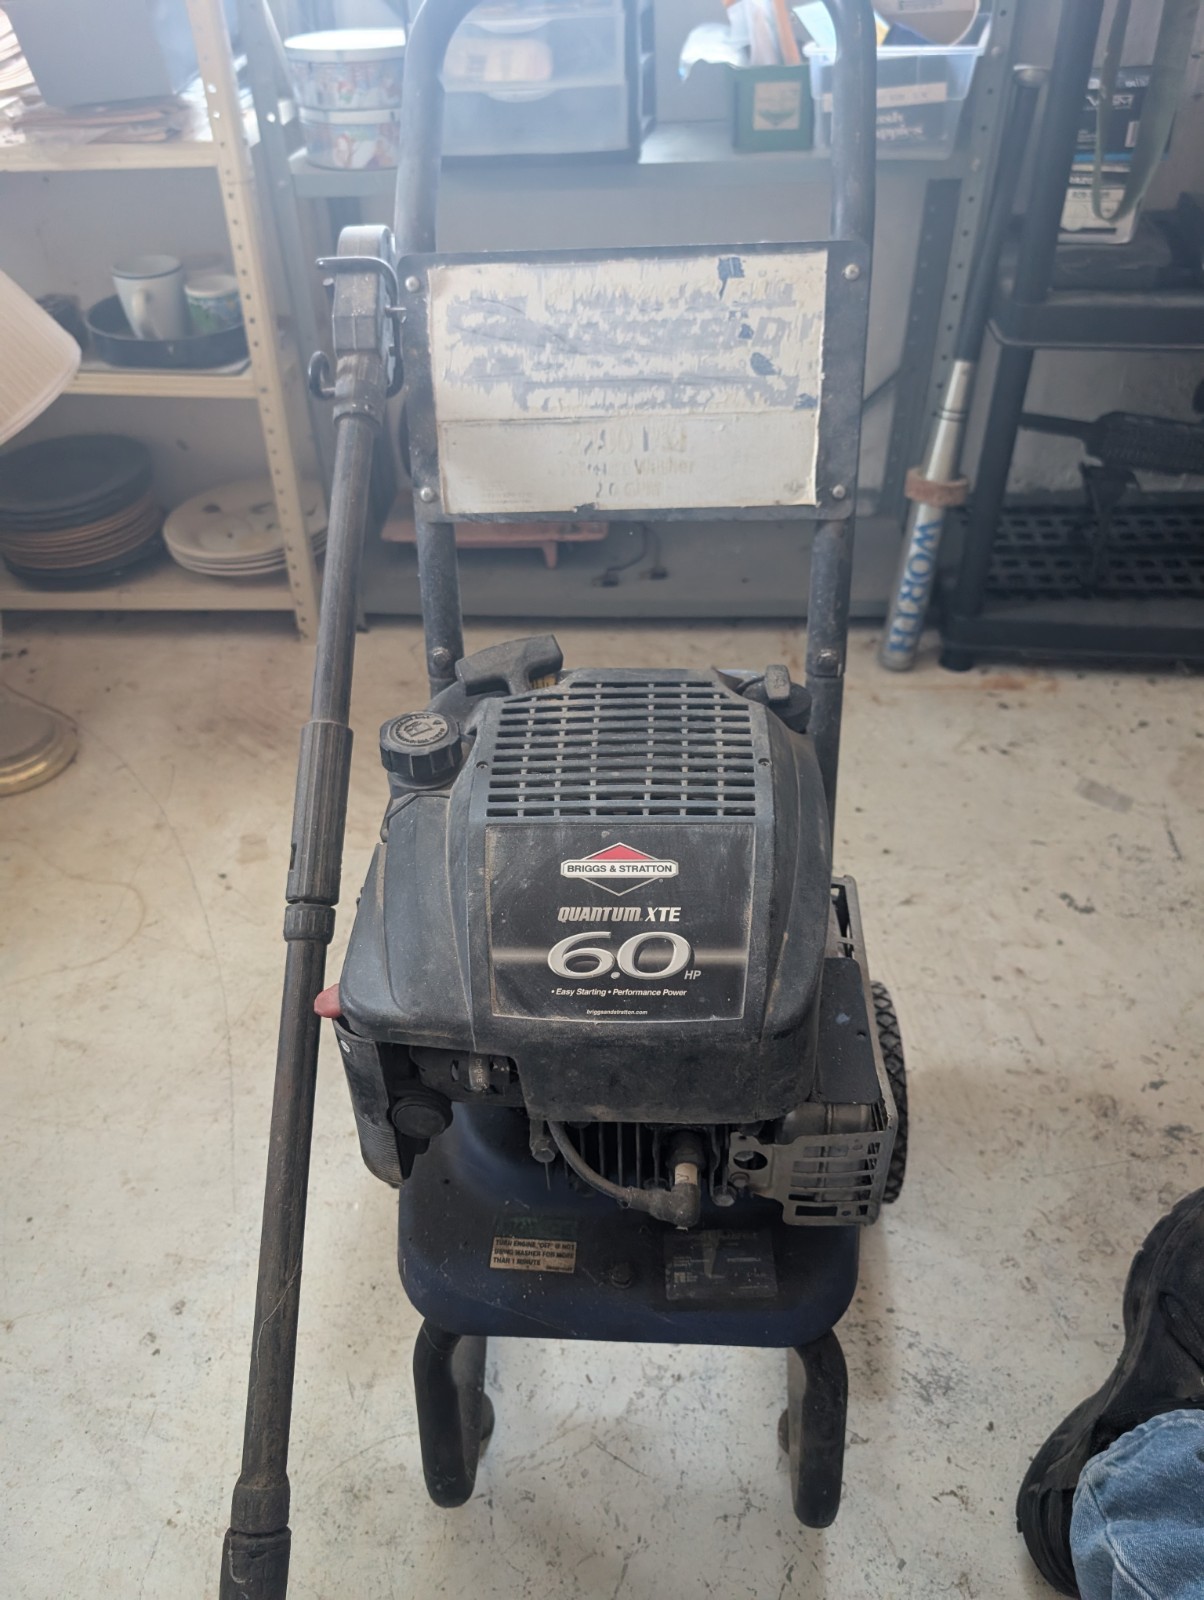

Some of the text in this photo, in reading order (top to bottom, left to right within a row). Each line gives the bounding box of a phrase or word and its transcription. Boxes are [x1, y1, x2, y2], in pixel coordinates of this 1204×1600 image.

[888, 519, 943, 651] WORTH
[567, 864, 673, 873] BRIGGS & STRATTON
[557, 906, 681, 923] QUANTUM XTE
[547, 931, 702, 981] 6.0 HP
[556, 988, 687, 997] Easy Starting Performance Power
[515, 1249, 541, 1257] WASHER
